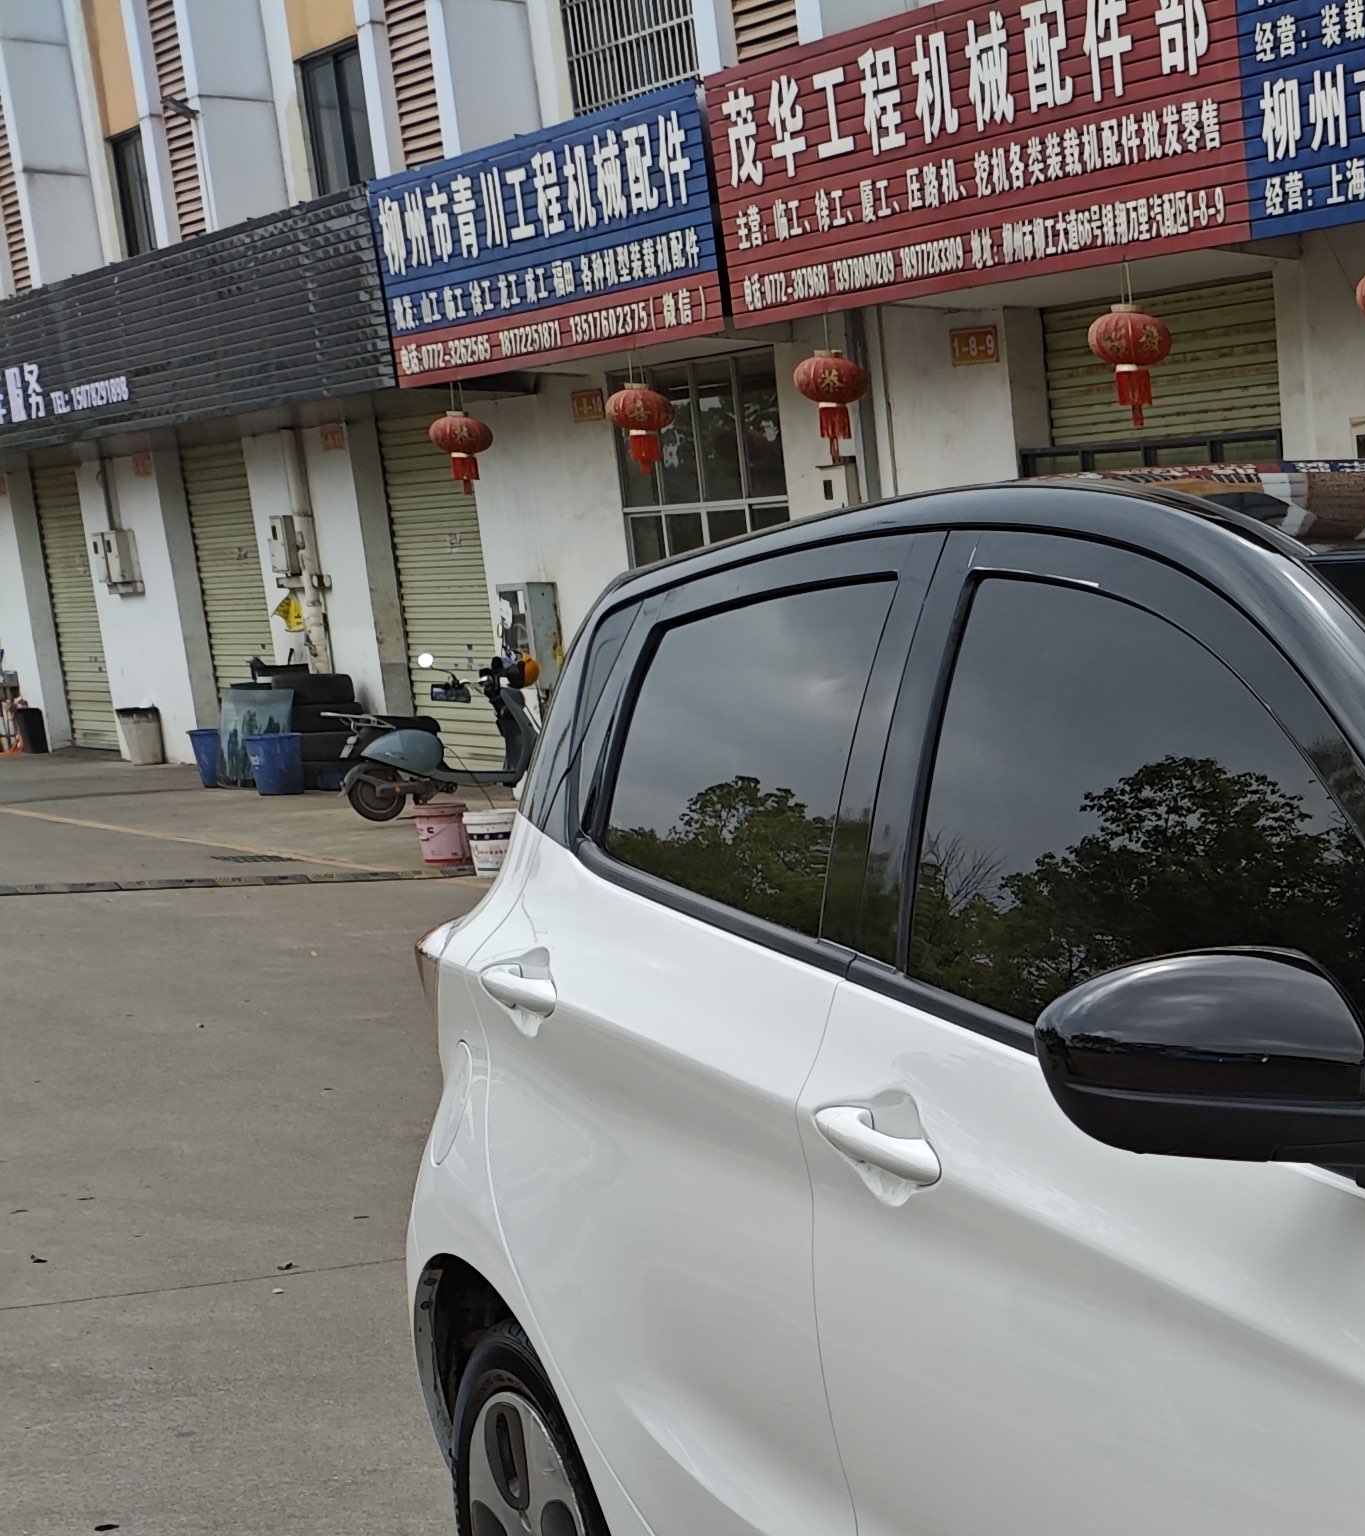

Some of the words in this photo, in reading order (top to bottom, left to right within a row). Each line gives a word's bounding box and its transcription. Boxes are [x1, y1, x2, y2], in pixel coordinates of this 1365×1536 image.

[722, 0, 1209, 189] 茂华工程机械配件部
[378, 110, 691, 276] 柳州市青川工程机械配件
[953, 335, 996, 358] 1-8-9
